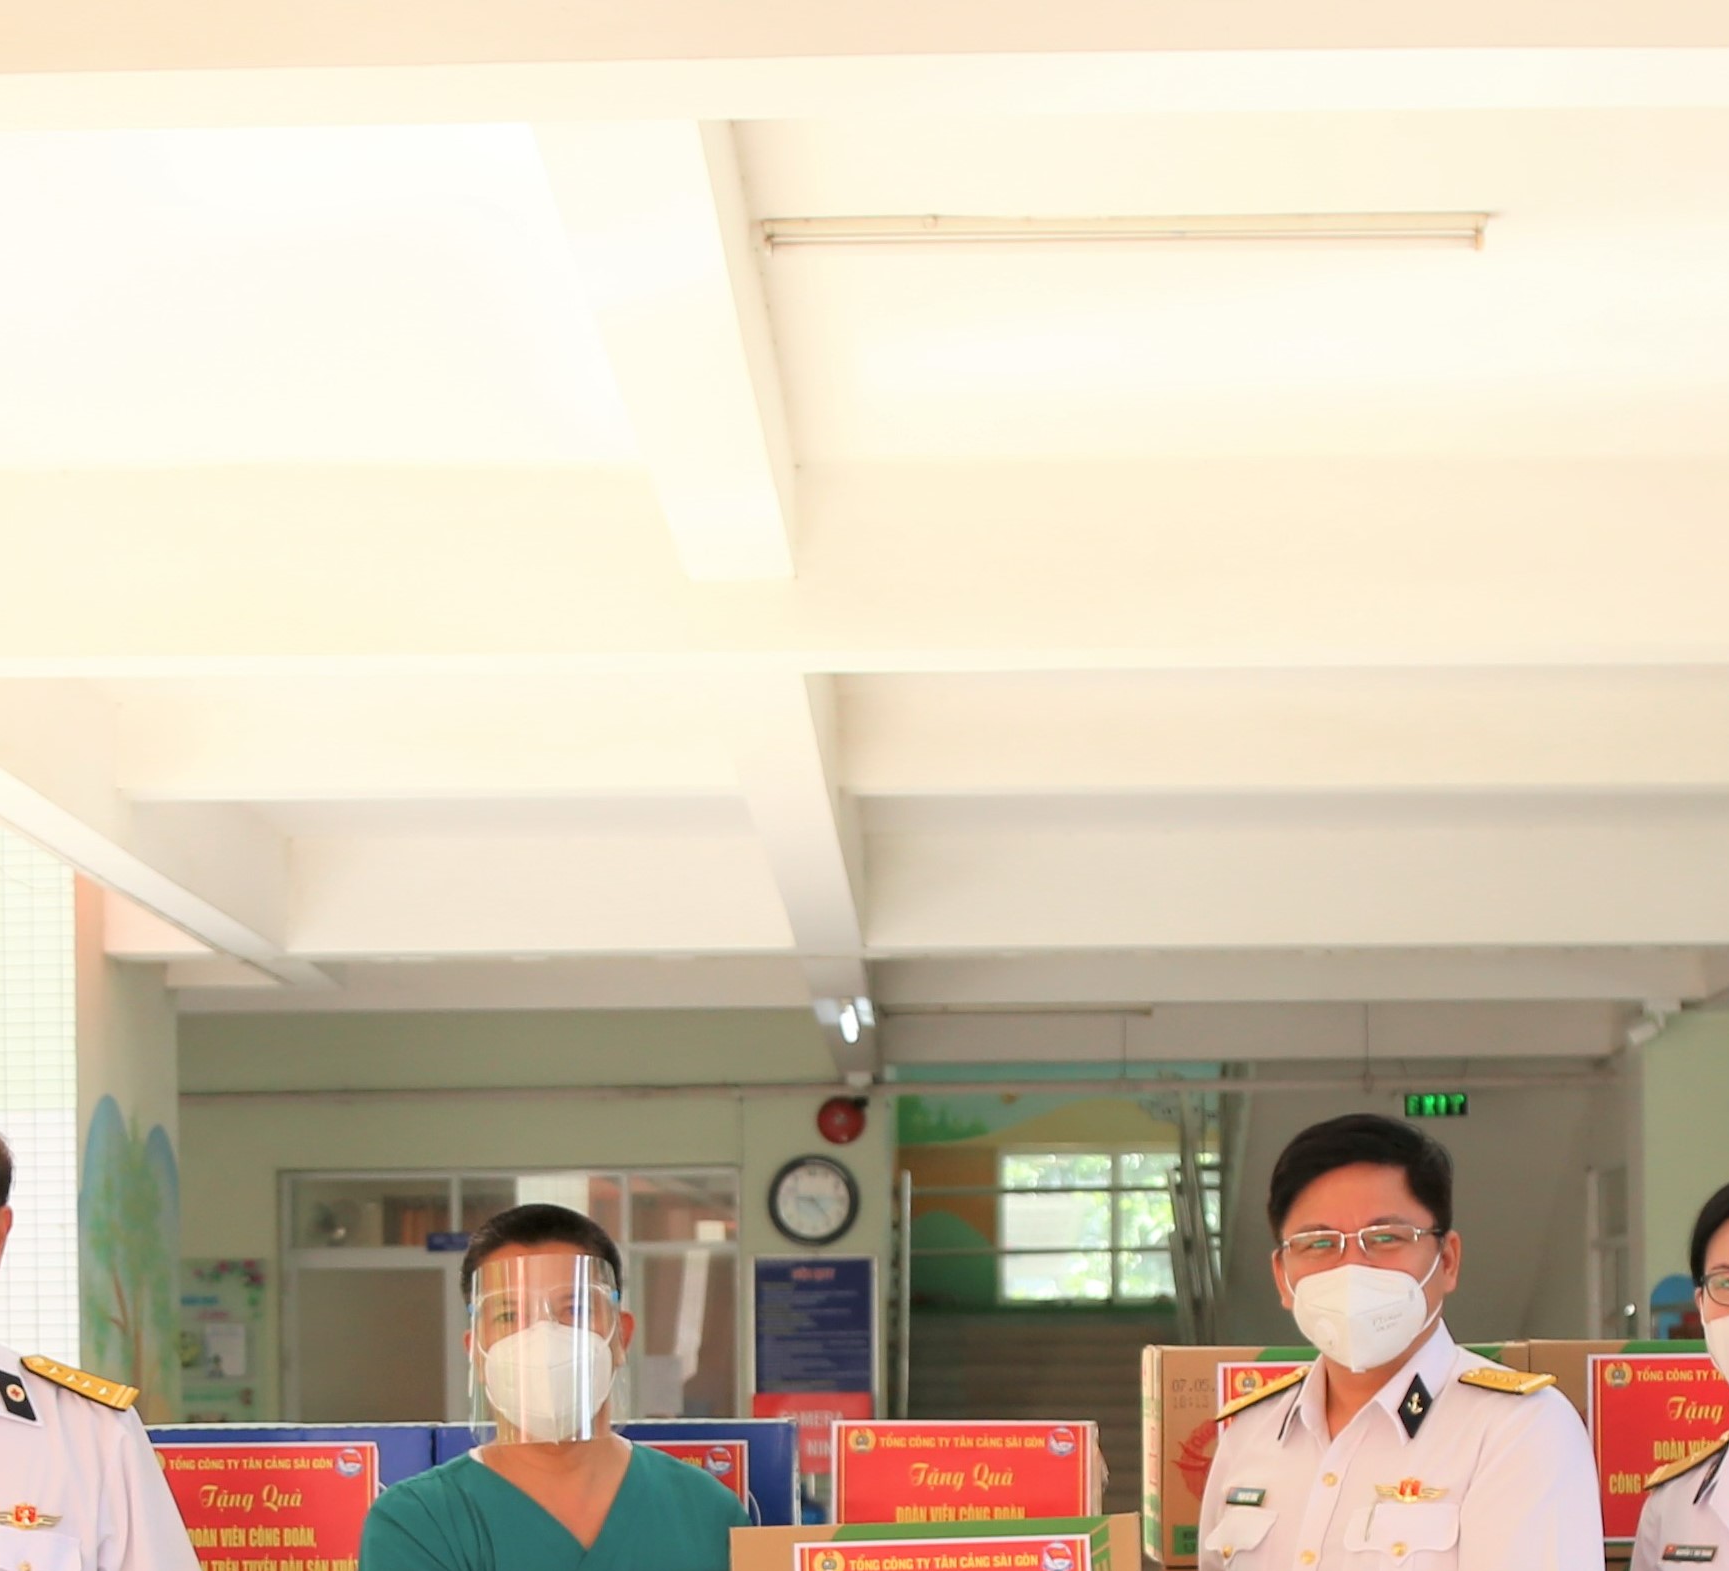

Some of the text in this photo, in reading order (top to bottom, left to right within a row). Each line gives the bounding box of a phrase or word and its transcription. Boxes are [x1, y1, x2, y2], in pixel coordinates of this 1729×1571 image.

[1637, 1365, 1709, 1381] TỔNG CÔNG TY
[1668, 1396, 1723, 1424] Tặng
[879, 1432, 1045, 1448] TỔNG CÔNG TY TÂN CẢNG SÀI GÒN
[1654, 1438, 1685, 1461] ĐOÀN
[170, 1455, 333, 1470] TỔNG CÔNG TY TÂN CẢNG SÀI GÒN
[910, 1462, 1015, 1491] Tặng Quà
[1609, 1471, 1641, 1494] CÔNG
[199, 1484, 303, 1512] Tặng Quà
[221, 1526, 245, 1547] VIÊN
[249, 1525, 280, 1547] CÔNG
[283, 1525, 317, 1548] ĐOÀN,
[849, 1552, 1038, 1571] TỔNG CÔNG TY TÂN CẢNG SÀI GÒN
